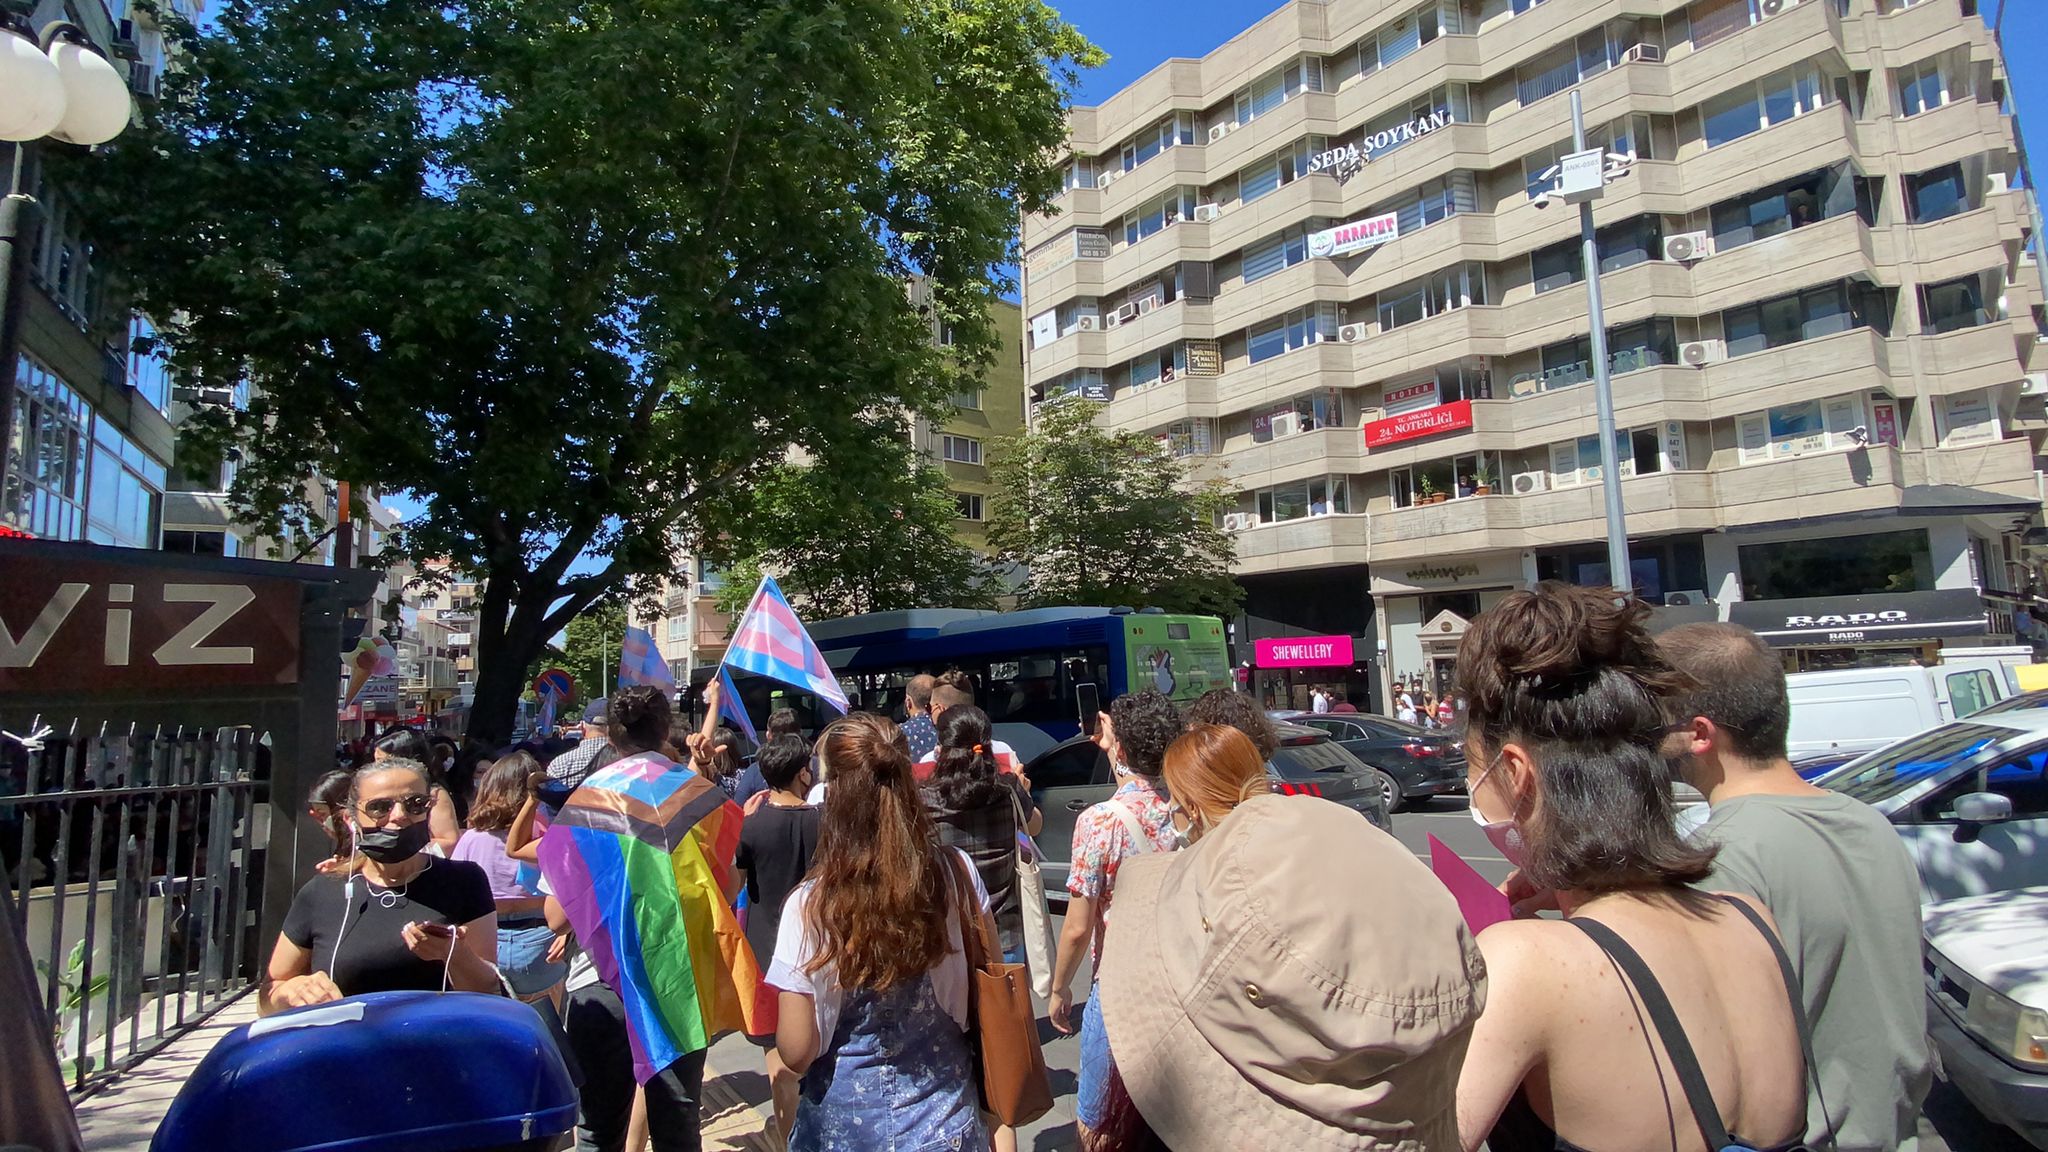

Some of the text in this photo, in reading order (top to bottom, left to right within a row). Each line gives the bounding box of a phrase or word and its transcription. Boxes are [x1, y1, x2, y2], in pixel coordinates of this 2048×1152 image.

[1310, 110, 1446, 172] SEDA SOYKAN
[1391, 384, 1429, 400] NOTER
[1379, 427, 1393, 438] 24.
[1394, 410, 1453, 434] NOTERLİĞİ
[1407, 411, 1433, 422] ANKARA
[1786, 610, 1907, 625] RADO
[1829, 631, 1864, 639] RADO
[1272, 643, 1333, 660] SHEWELLERY
[360, 684, 396, 693] ZANE
